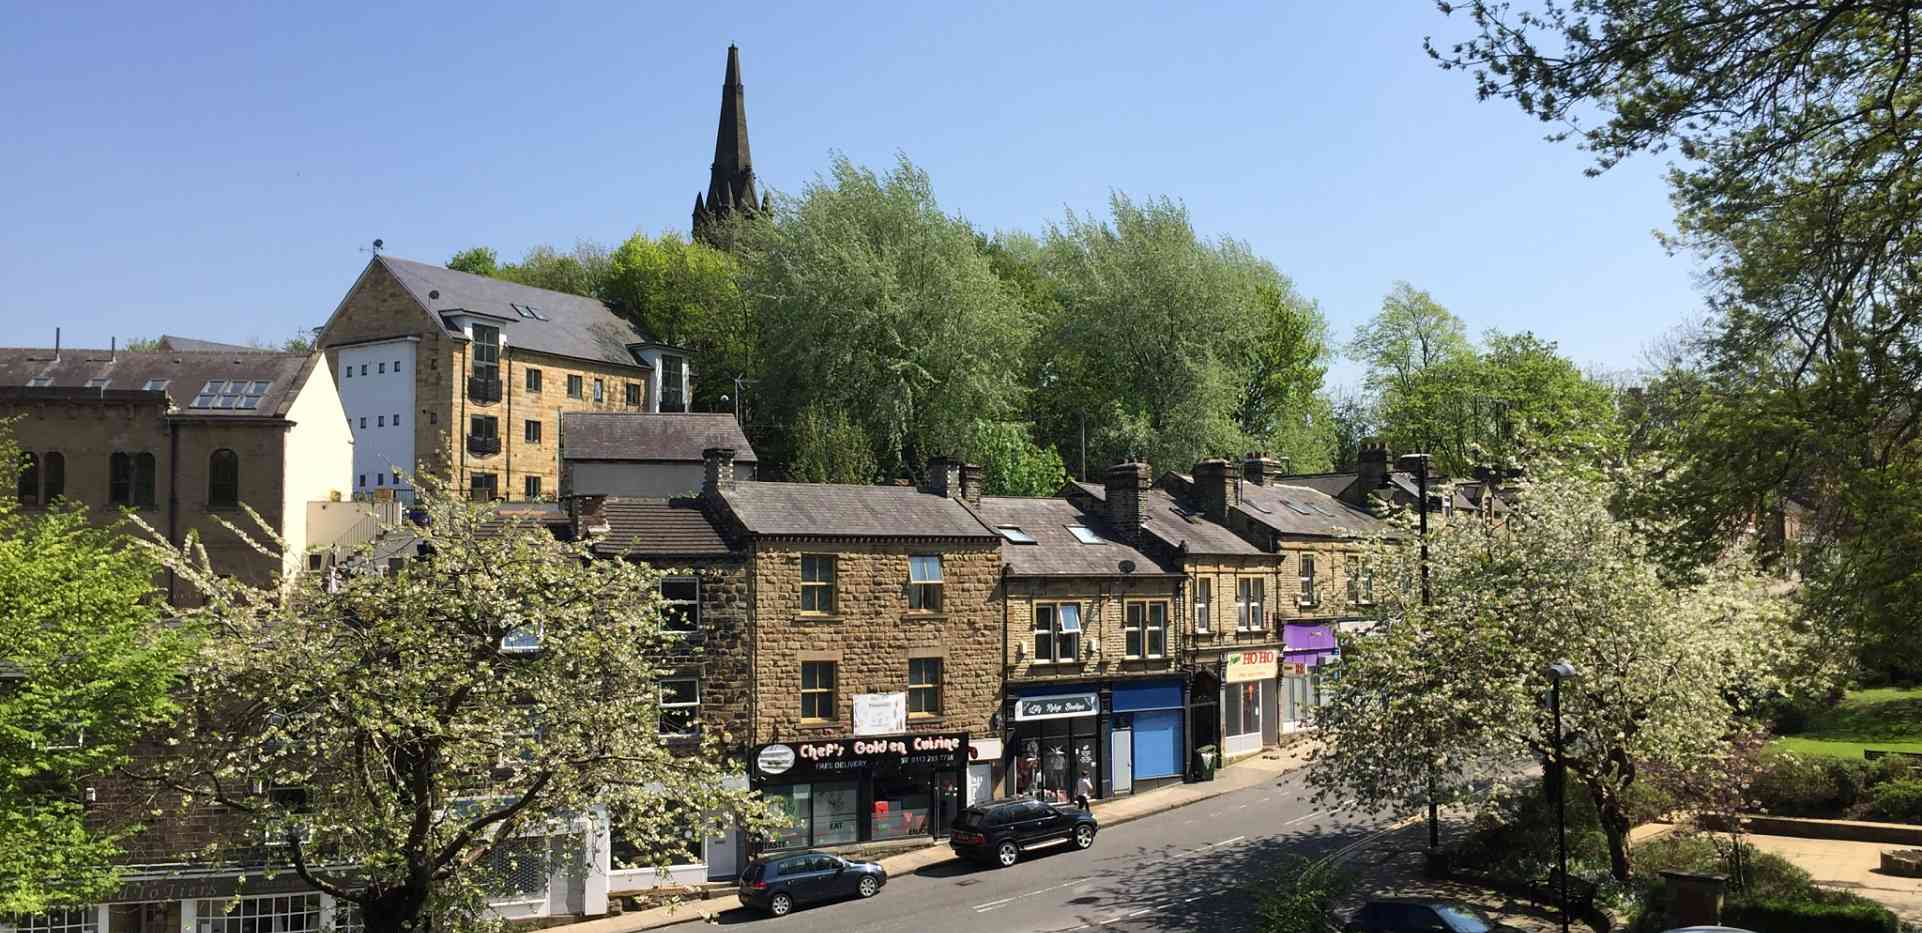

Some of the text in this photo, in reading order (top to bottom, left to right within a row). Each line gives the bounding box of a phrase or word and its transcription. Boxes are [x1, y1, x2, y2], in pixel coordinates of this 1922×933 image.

[1243, 651, 1274, 665] HO HO
[800, 736, 960, 760] Chef's Golden Cuisine
